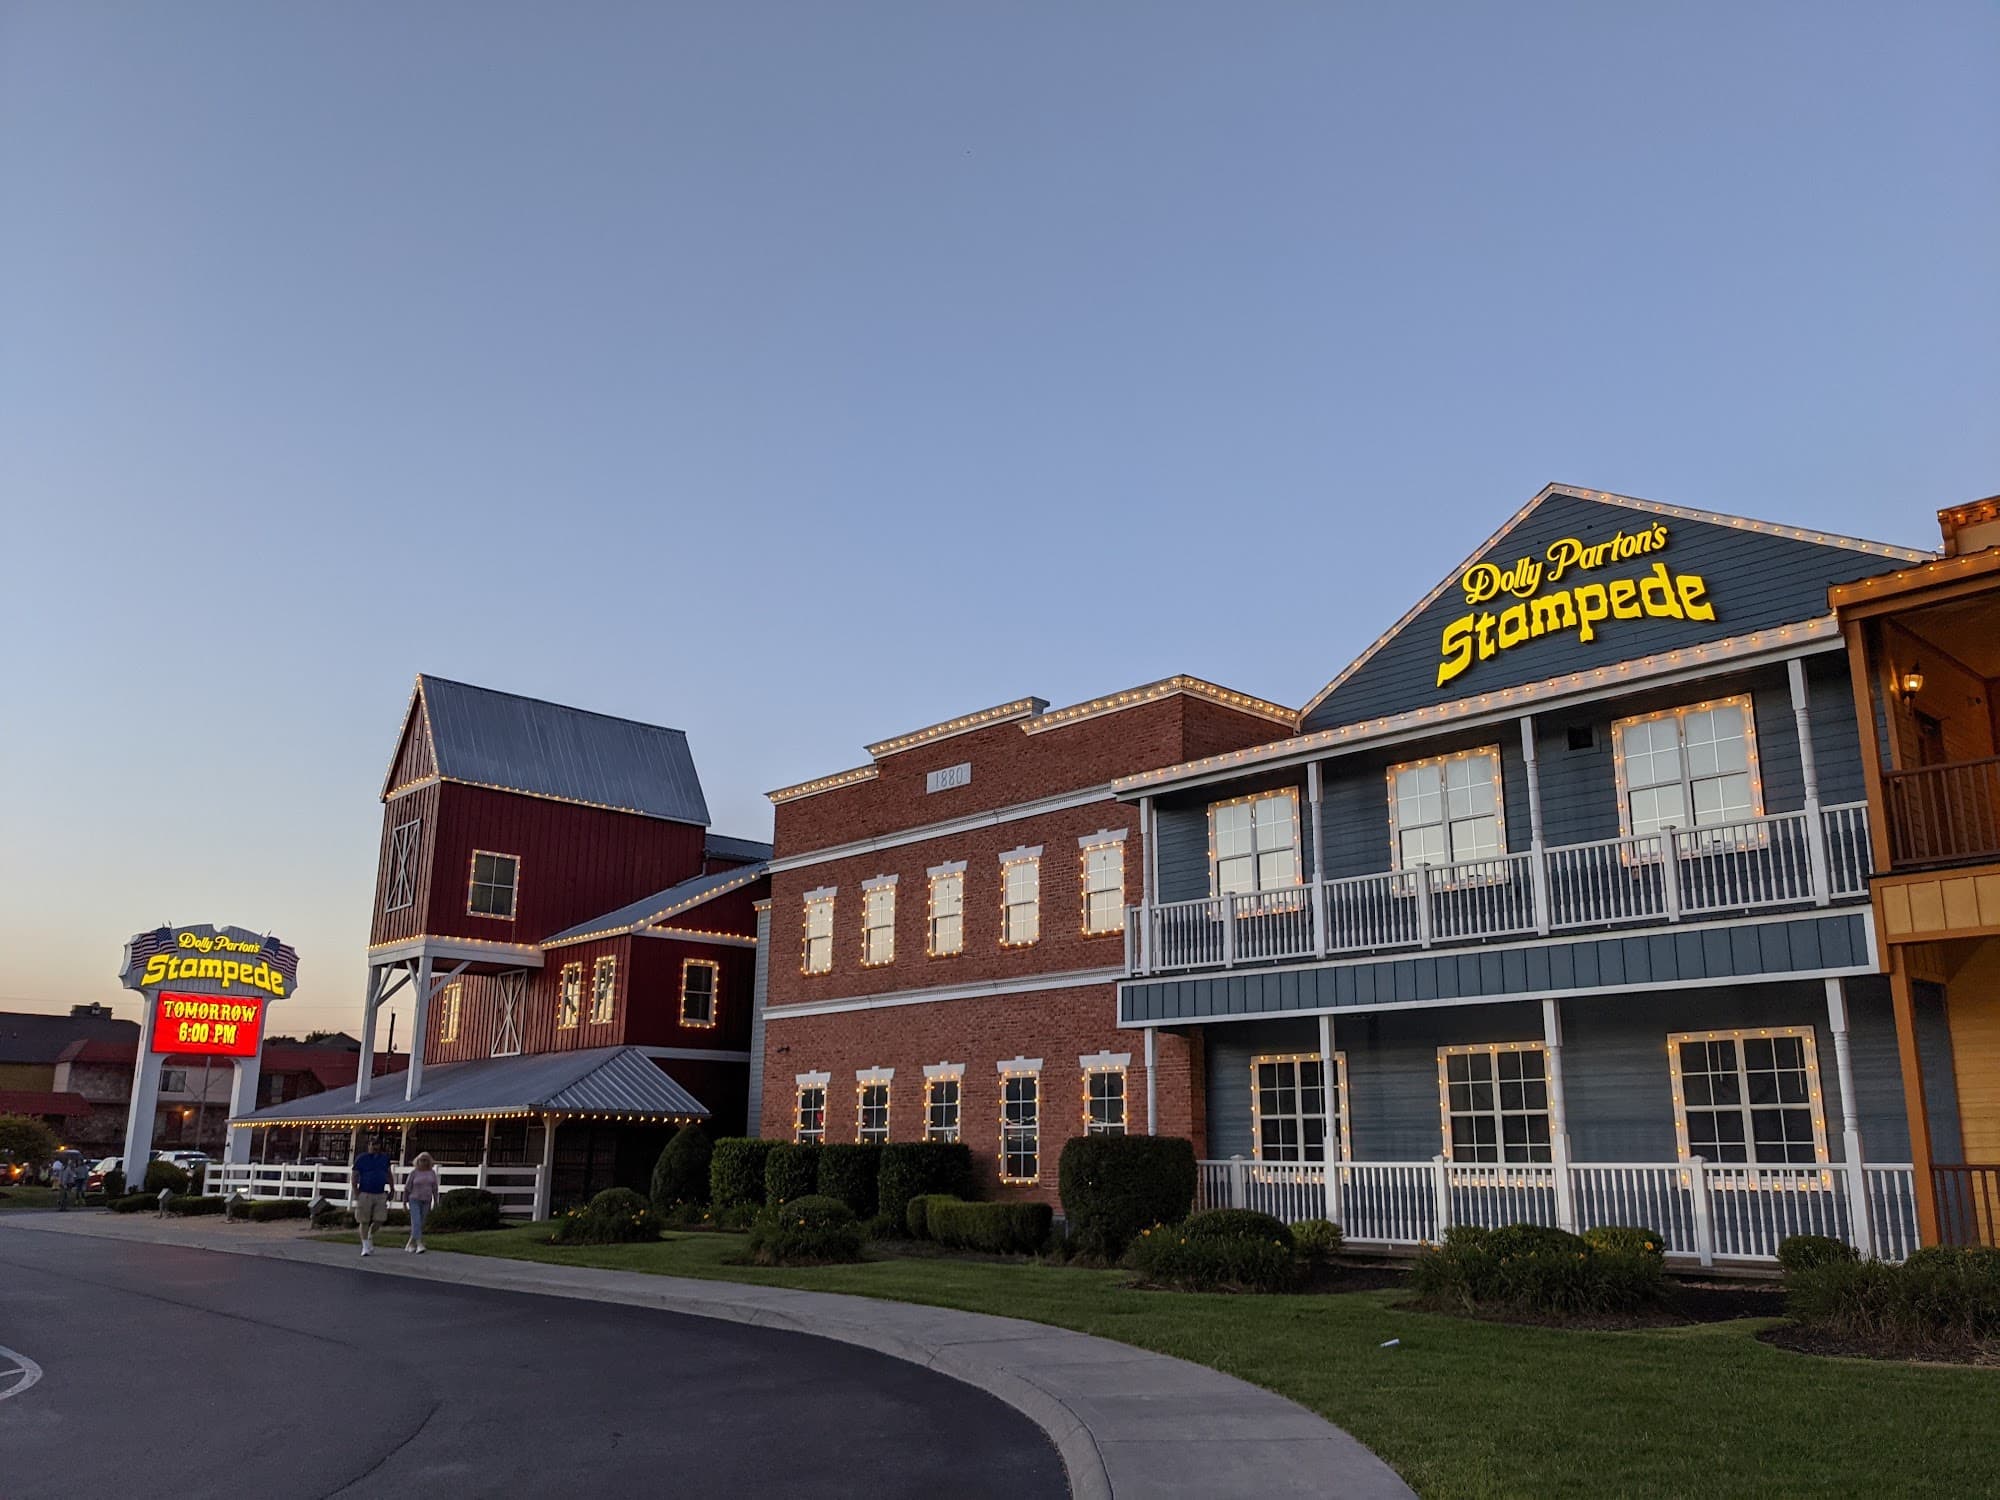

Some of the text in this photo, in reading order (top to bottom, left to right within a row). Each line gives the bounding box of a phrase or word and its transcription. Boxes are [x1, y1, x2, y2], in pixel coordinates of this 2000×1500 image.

[1462, 521, 1668, 605] Dolly Parton's
[1436, 562, 1716, 688] Stampede
[935, 766, 964, 788] 1880
[178, 932, 261, 953] Dolly Parton's
[141, 954, 285, 995] Stampede
[164, 1000, 257, 1022] TOMORROW
[178, 1022, 237, 1044] 6:00 PM
